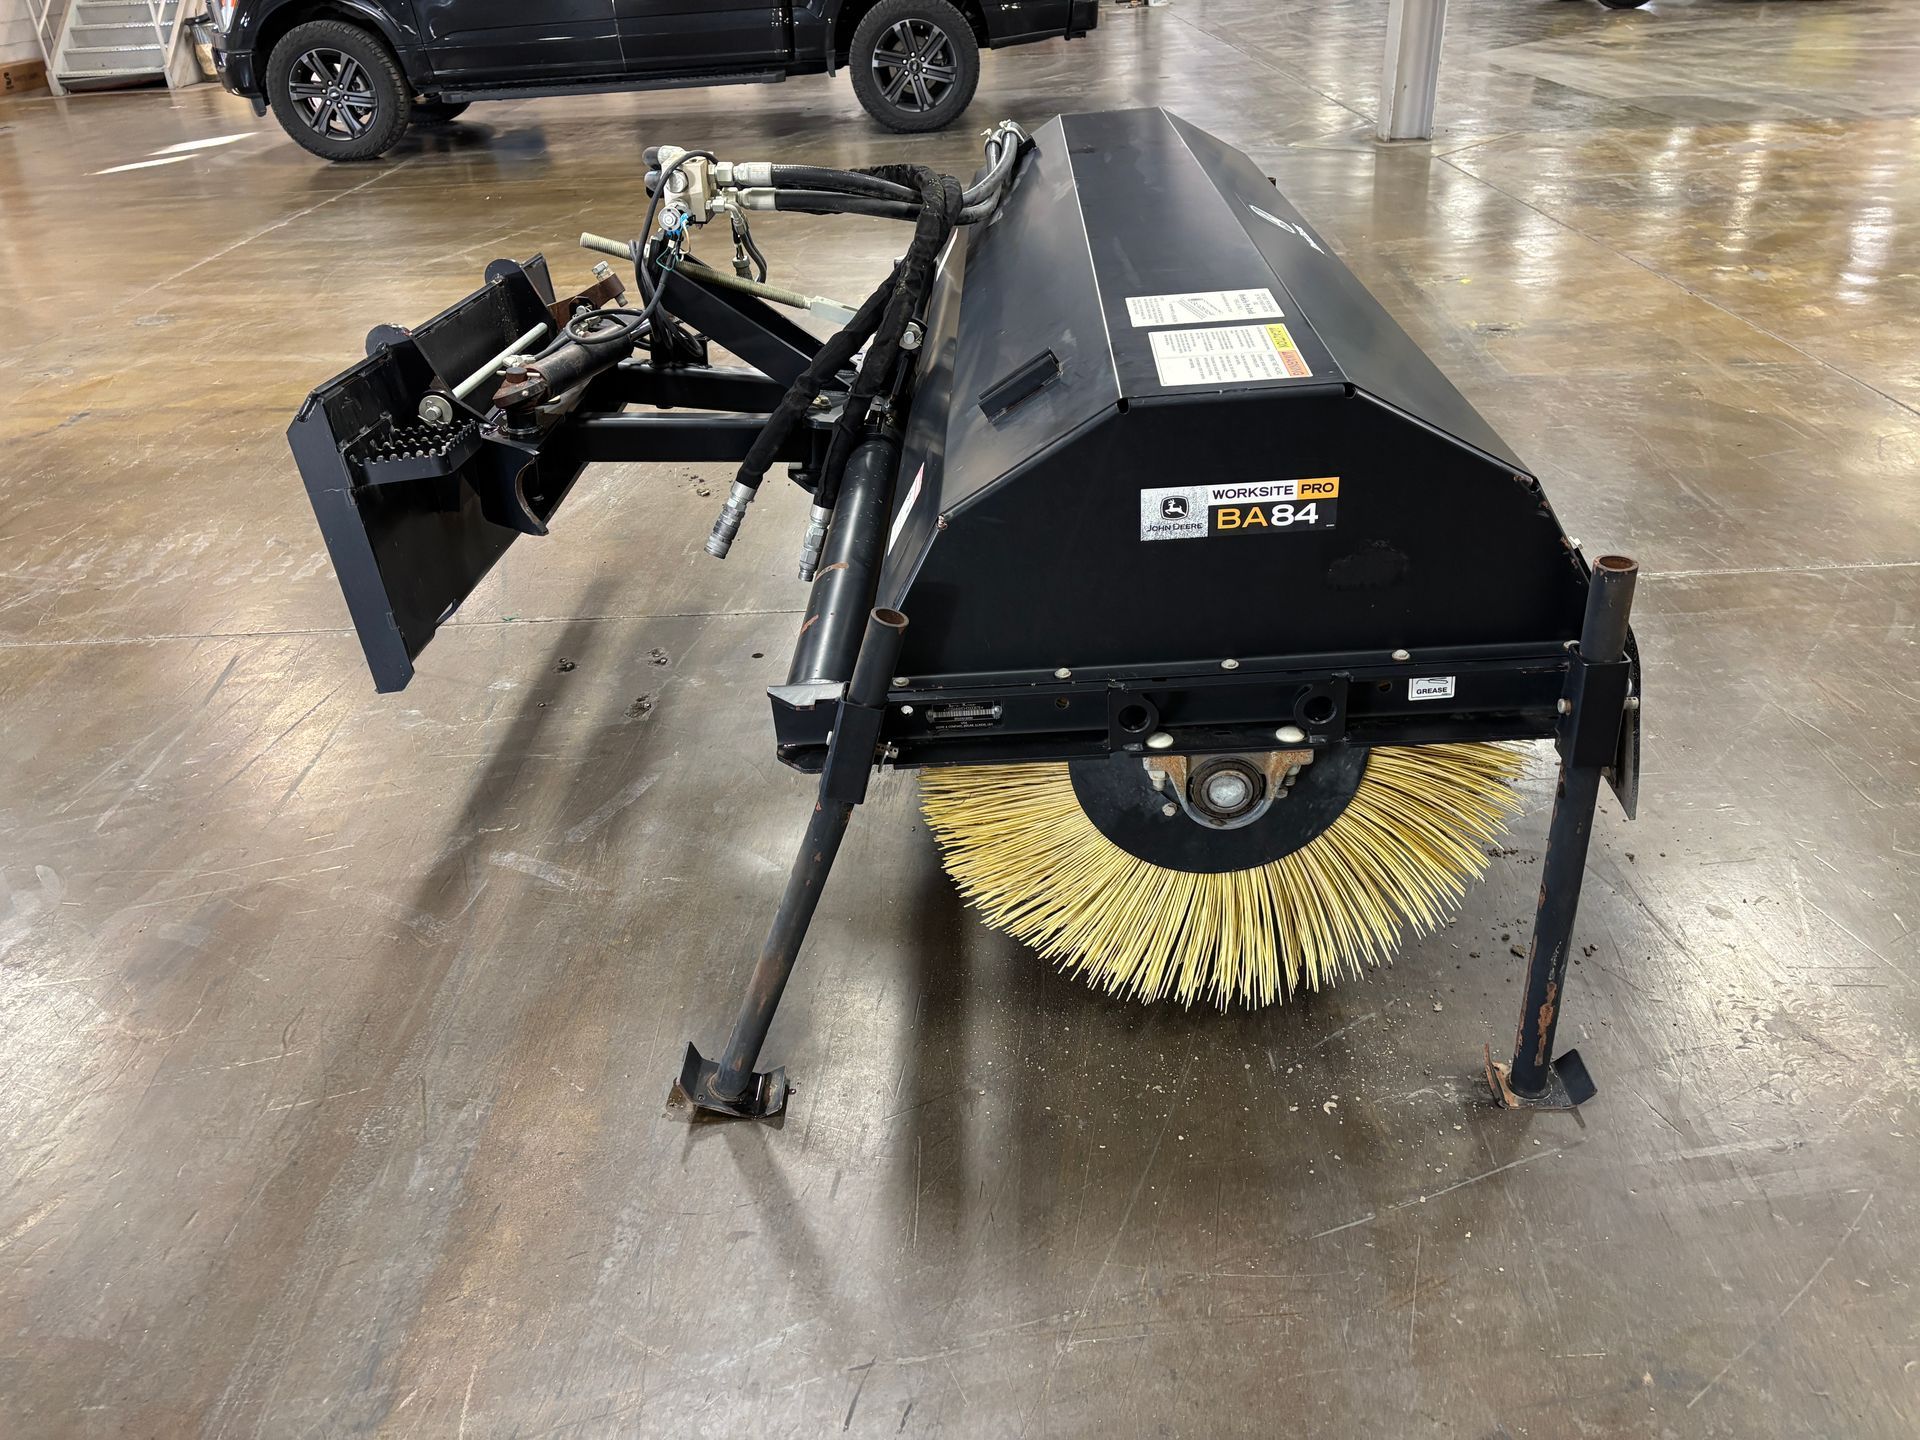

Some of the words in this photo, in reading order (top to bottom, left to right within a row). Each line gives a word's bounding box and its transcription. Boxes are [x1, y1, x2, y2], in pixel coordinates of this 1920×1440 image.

[1213, 485, 1294, 499] WORKSITE
[1301, 482, 1335, 494] PRO
[1217, 502, 1319, 530] BA84
[1147, 524, 1171, 532] JOHN
[1172, 522, 1203, 531] DEERE
[1416, 686, 1448, 695] GREASE
